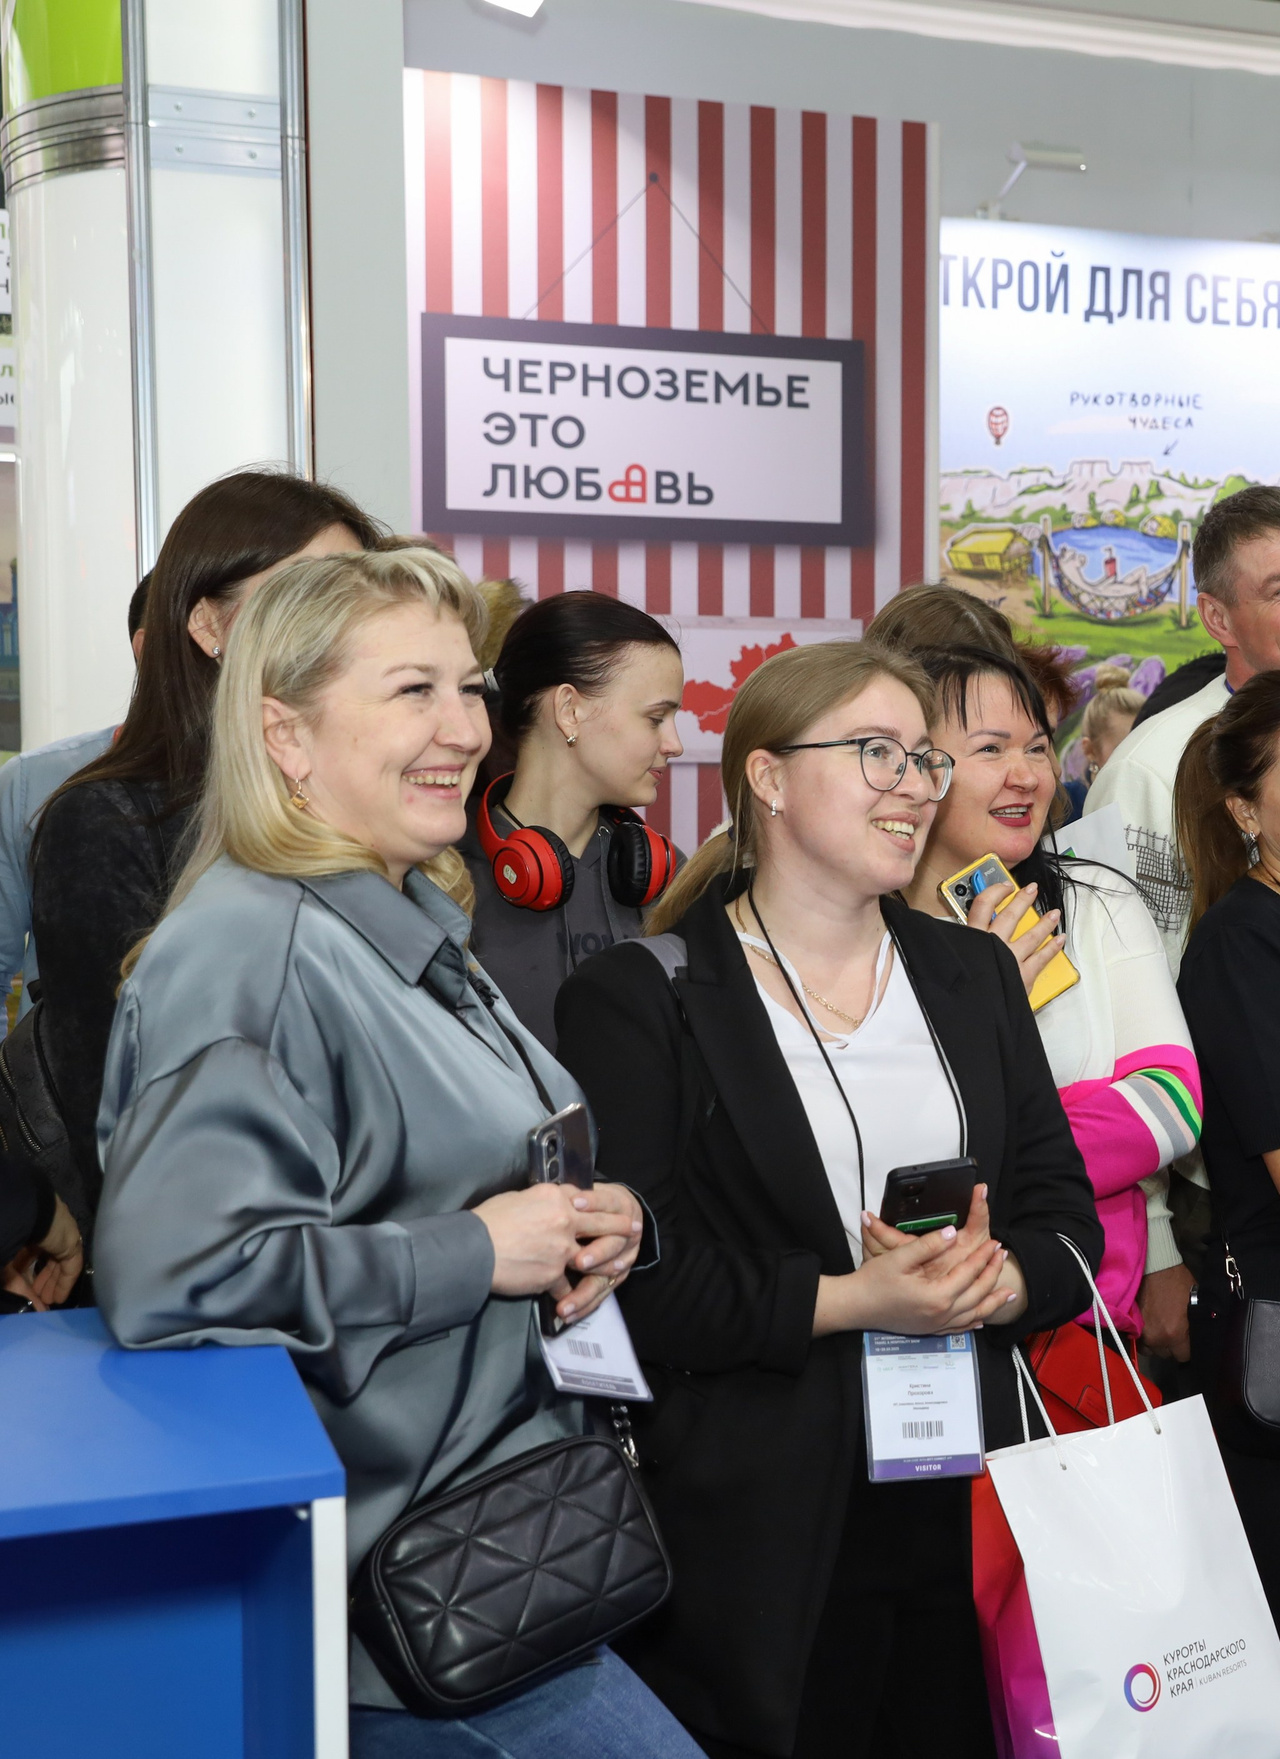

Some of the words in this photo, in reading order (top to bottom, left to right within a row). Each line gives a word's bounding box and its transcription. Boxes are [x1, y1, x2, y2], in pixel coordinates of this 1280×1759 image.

[939, 250, 1069, 314] ТКРОЙ
[1084, 266, 1171, 324] ДЛЯ
[483, 357, 810, 409] ЧЕРНОЗЕМЬЕ
[1070, 391, 1203, 410] РУКОТВОРНЫЕ
[483, 412, 586, 449] ЭТО
[1128, 416, 1194, 430] ЧУДЕСА
[915, 1464, 942, 1472] VISITOR
[1163, 1639, 1207, 1666] КУРОРТЫ
[1166, 1639, 1247, 1682] КРАСНОДАРСКОГО
[1169, 1678, 1194, 1698] КРАЯ
[1199, 1670, 1222, 1686] KUBAN
[1221, 1659, 1248, 1676] RESORTS
